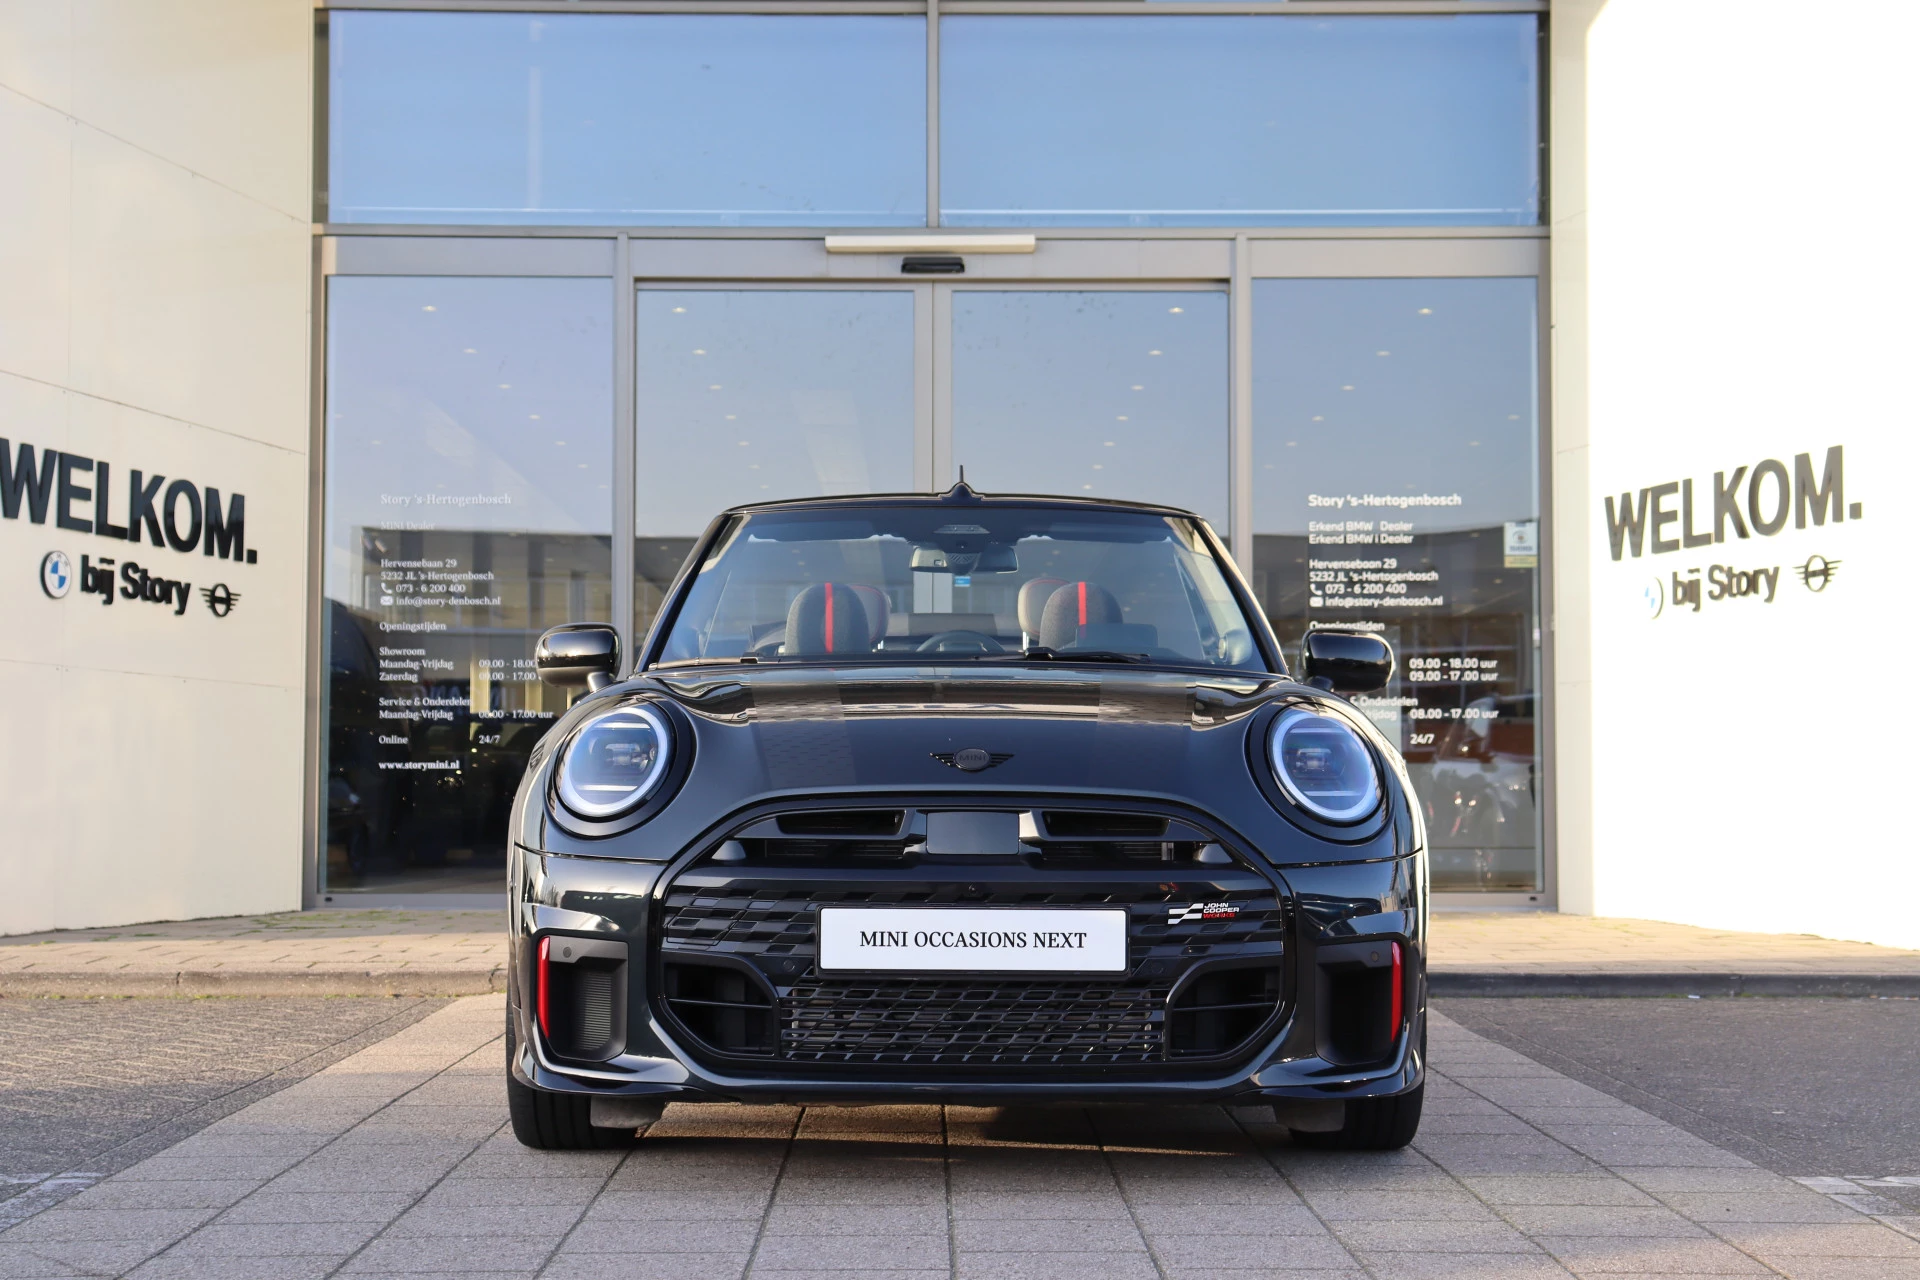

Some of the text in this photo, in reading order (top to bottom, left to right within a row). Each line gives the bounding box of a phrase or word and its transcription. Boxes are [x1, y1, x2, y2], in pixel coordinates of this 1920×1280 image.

[0, 437, 257, 564] WELKOM.
[380, 494, 410, 507] Story
[1308, 494, 1345, 509] Story
[1604, 445, 1862, 561] WELKOM.
[1309, 521, 1413, 531] Erkend BMW Dealer
[1309, 534, 1344, 544] Erkend
[1346, 534, 1374, 544] BMW
[1380, 534, 1413, 544] Dealer
[380, 559, 458, 568] Hervensebaan 29
[1309, 559, 1397, 569] Hervensebaan 29
[380, 571, 403, 581] 5232
[404, 571, 416, 581] JL
[1309, 571, 1334, 582] 5232
[1336, 571, 1348, 582] JL
[81, 554, 191, 615] bij Story
[395, 584, 413, 593] 073
[421, 584, 427, 593] 6
[429, 584, 446, 593] 200
[448, 584, 465, 593] 400
[1325, 584, 1344, 594] 073
[1354, 584, 1361, 594] 6
[1362, 584, 1383, 594] 200
[1385, 584, 1407, 594] 400
[1672, 564, 1780, 612] bij Story
[396, 596, 501, 607] info@story-denbosch.nl
[1326, 596, 1443, 608] info@story-denbosch.nl
[379, 622, 446, 633] Openingstijden
[379, 646, 426, 656] Showroom
[379, 659, 454, 670] Maandag-Vrijdag
[1409, 658, 1440, 668] 09.00
[1450, 658, 1478, 668] 18.00
[1480, 659, 1497, 668] uur
[379, 672, 418, 683] Zaterdag
[512, 672, 536, 681] 17.00
[1409, 671, 1440, 681] 09.00
[1481, 672, 1498, 681] uur
[379, 697, 473, 706] Service & Onderdelen
[1360, 696, 1418, 707] Onderdelen
[379, 710, 454, 721] Maandag-Vrijdag
[512, 710, 536, 719] 17.00
[538, 711, 553, 719] uur
[1410, 708, 1442, 719] 08.00
[1481, 710, 1499, 719] uur
[379, 735, 500, 744] Online 24/7
[1410, 734, 1435, 744] 24/7
[379, 760, 460, 770] www.storymini.nl
[860, 930, 1087, 949] MINI OCCASIONS NEXT
